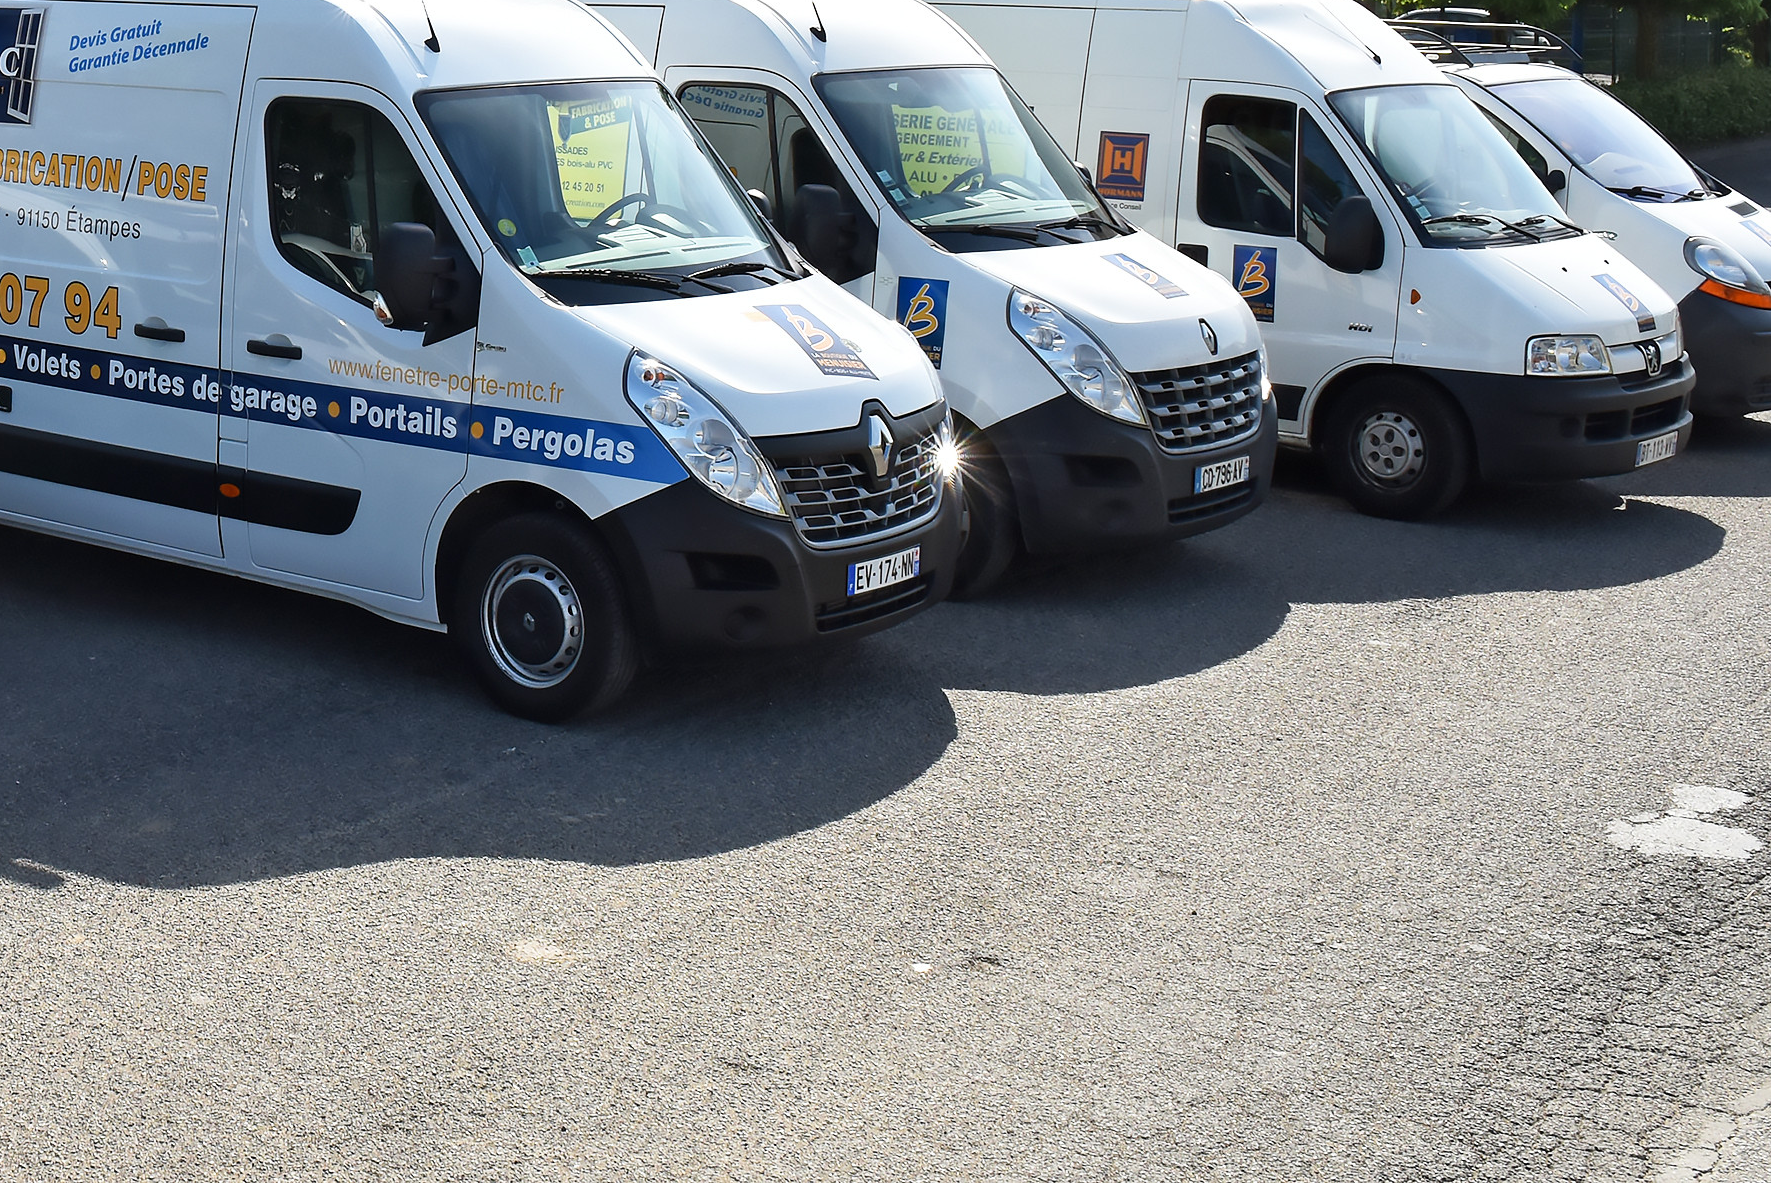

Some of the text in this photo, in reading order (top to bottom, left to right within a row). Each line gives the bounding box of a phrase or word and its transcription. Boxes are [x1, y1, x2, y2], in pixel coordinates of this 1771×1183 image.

[69, 19, 163, 51] Devis Gratuit
[68, 32, 210, 73] Garantie Décennale
[584, 111, 616, 129] & POSE
[893, 113, 933, 130] SERIE
[896, 132, 970, 148] GENCEMENT
[597, 161, 613, 169] PVC
[908, 170, 937, 183] ALU
[572, 182, 582, 191] 45
[584, 183, 593, 192] 20
[596, 184, 605, 193] 51
[1119, 202, 1142, 210] Conseil
[16, 209, 60, 231] 91150
[66, 205, 141, 242] Étampes
[64, 280, 122, 340] 94
[328, 357, 565, 405] www.fenetre-porte-mtc.fr
[13, 343, 81, 380] Volets
[109, 359, 185, 397] Portes
[192, 374, 222, 403] de
[230, 384, 318, 421] garage
[350, 396, 458, 439] Portails
[493, 415, 635, 464] Pergolas
[856, 551, 914, 591] EV-174-NN
